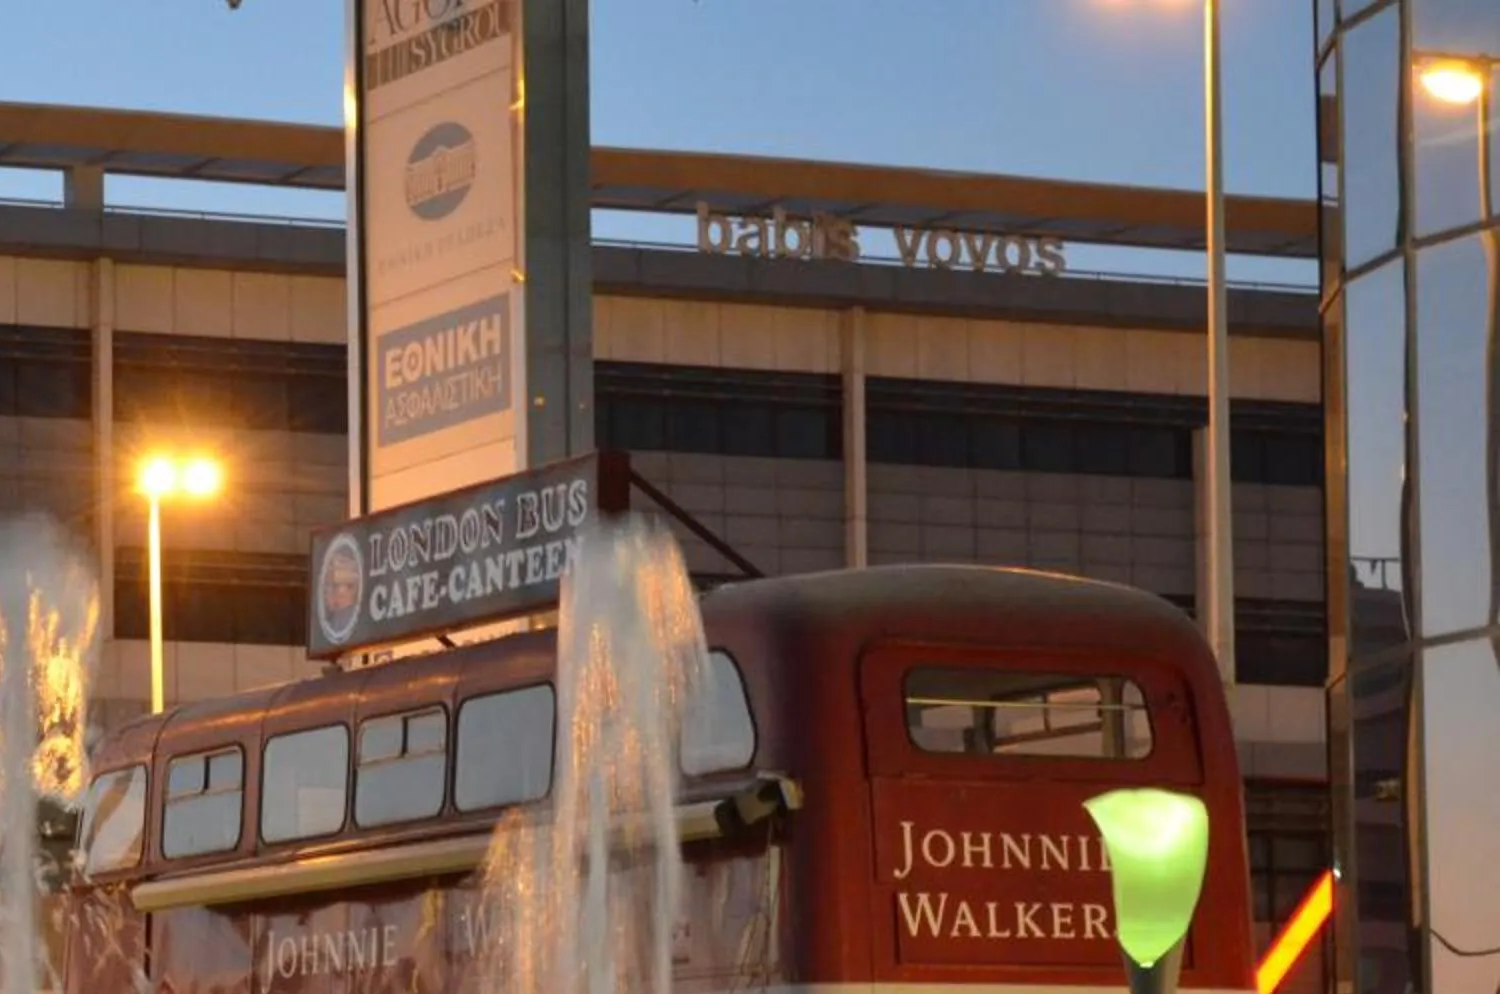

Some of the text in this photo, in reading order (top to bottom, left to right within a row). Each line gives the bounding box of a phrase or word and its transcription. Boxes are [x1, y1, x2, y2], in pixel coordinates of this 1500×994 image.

[696, 202, 1064, 277] babis vovos
[385, 313, 501, 390] ΕΘΝΙΚΗ
[368, 479, 588, 577] LONDON BUS
[368, 535, 585, 622] CAFE-CANTEEN
